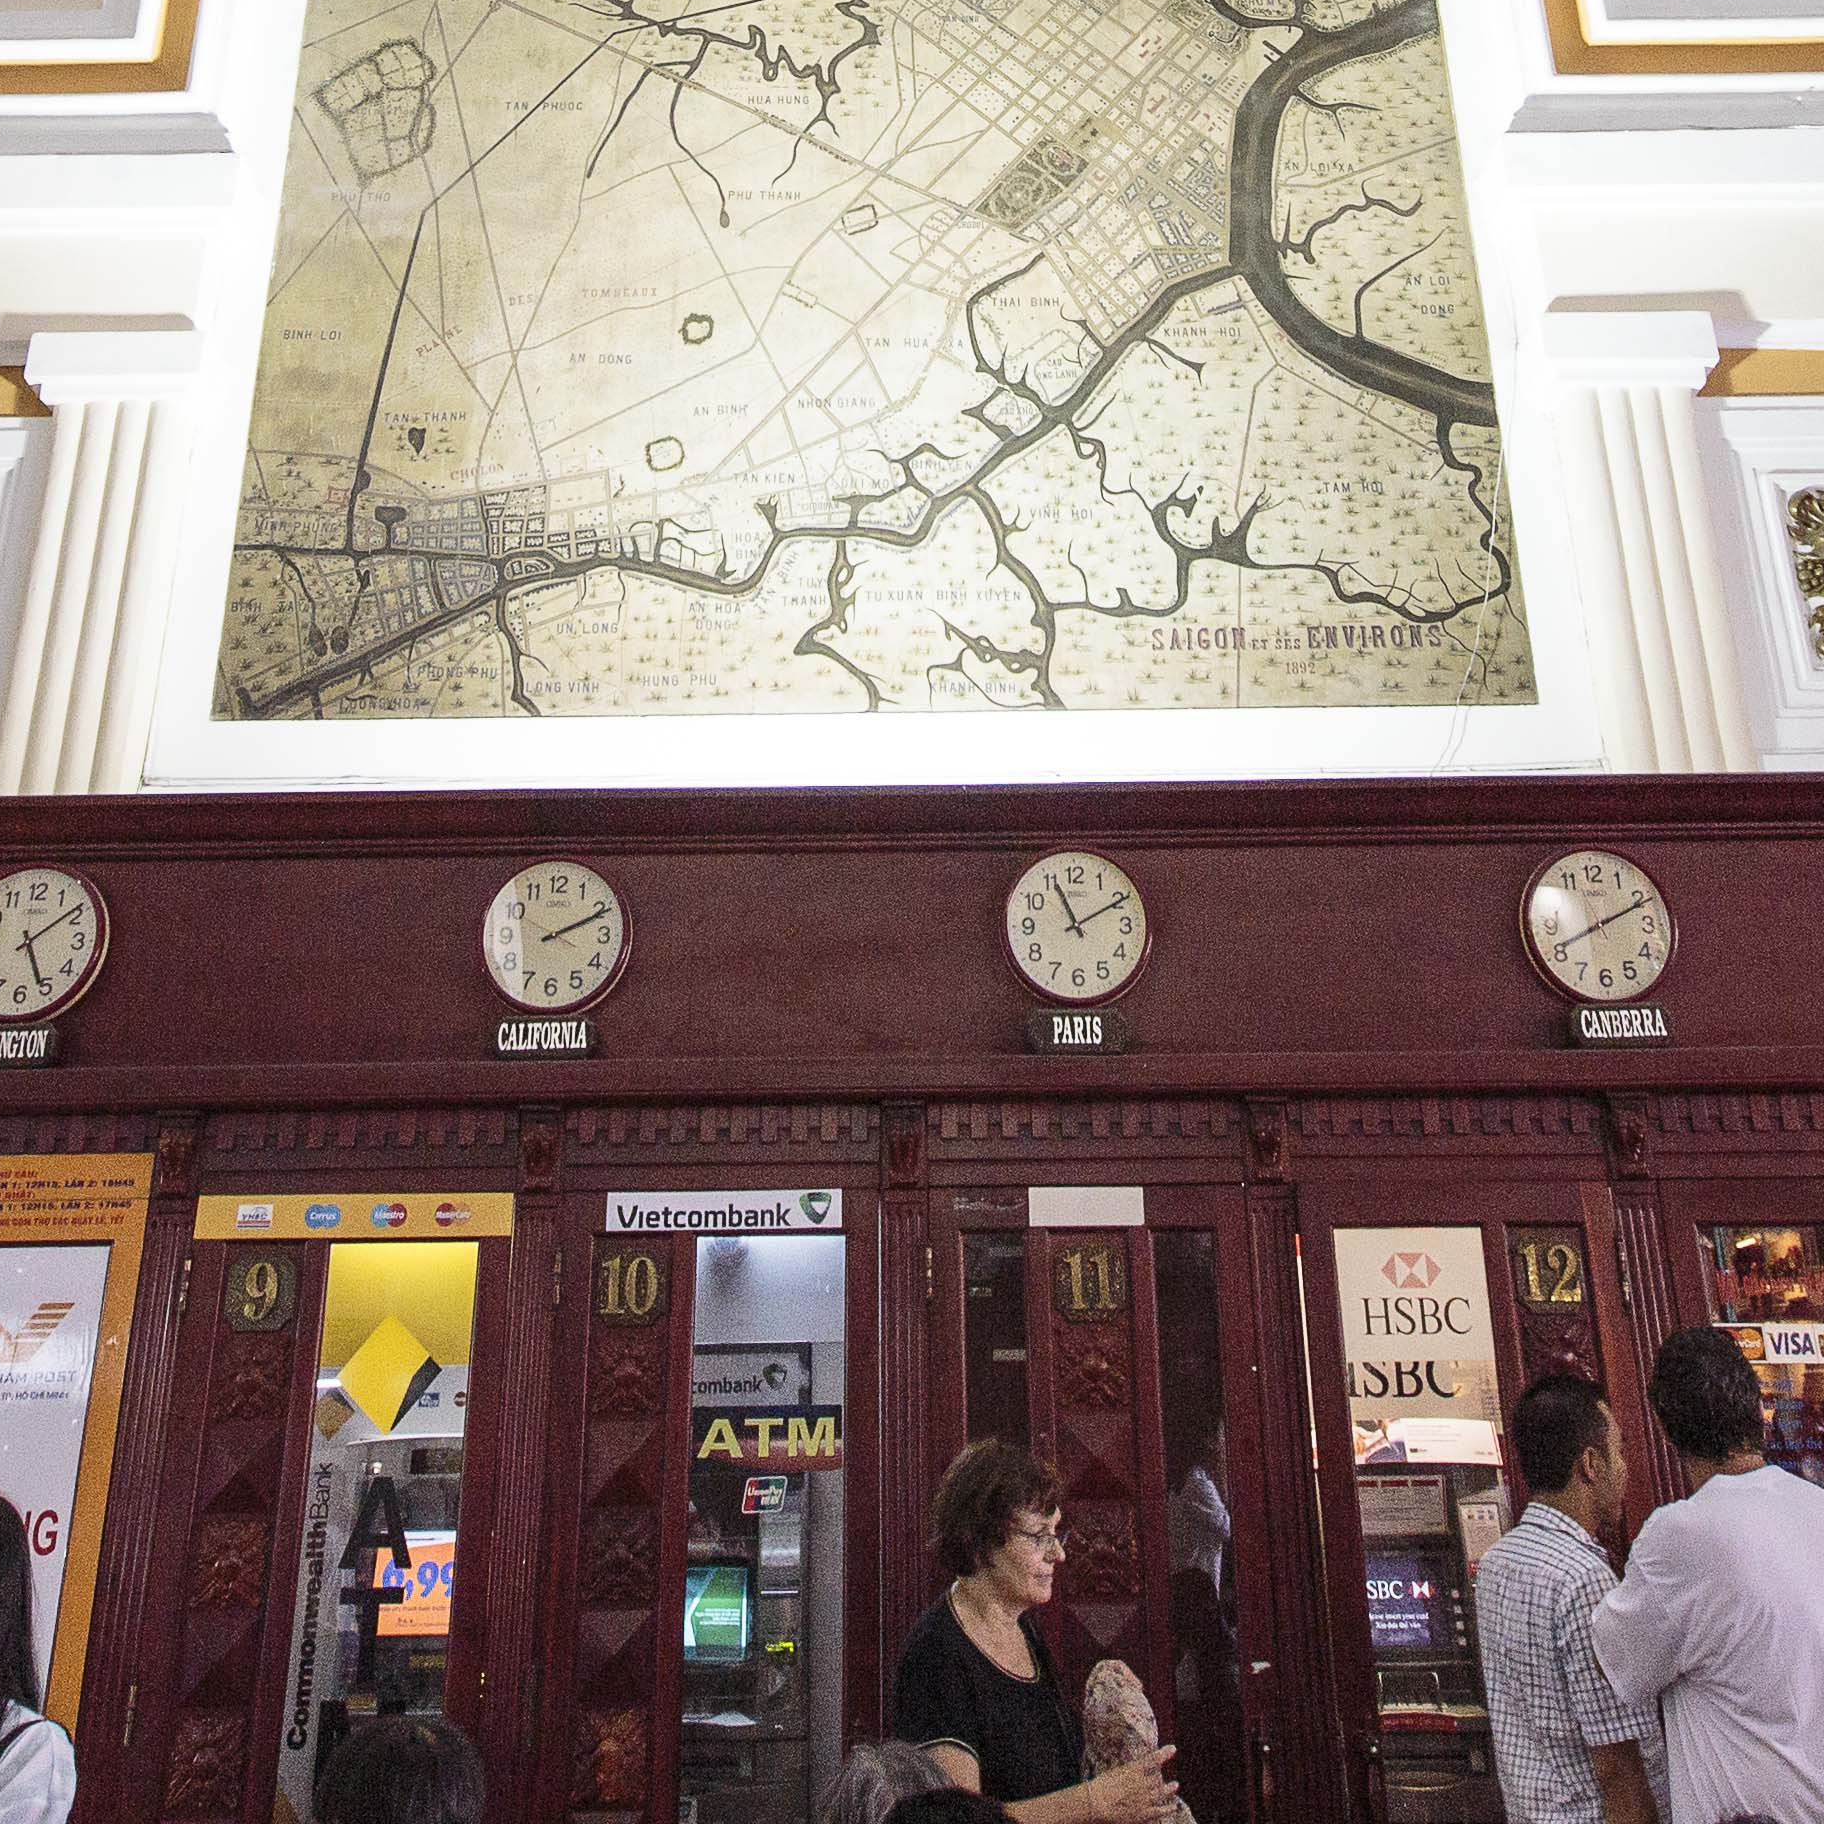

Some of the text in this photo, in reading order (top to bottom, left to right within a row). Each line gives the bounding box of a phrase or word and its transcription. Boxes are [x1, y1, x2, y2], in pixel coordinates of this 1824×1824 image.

[504, 101, 528, 111] TAN
[777, 95, 810, 105] HUNG
[727, 190, 801, 201] PHU THANH
[992, 297, 1060, 307] THAI BINH
[282, 329, 342, 341] BINH LOI
[1163, 327, 1208, 337] KHANH
[865, 338, 890, 348] TAN
[569, 352, 633, 365] AN DONG
[692, 404, 746, 416] AN BINH
[798, 398, 832, 408] NHON
[384, 411, 467, 423] TAN THANH
[911, 459, 941, 470] BINH
[764, 473, 795, 484] KIEN
[1323, 481, 1352, 493] TAM
[1029, 507, 1061, 520] VINH
[936, 590, 968, 601] BINH
[689, 603, 706, 614] AN
[582, 623, 619, 634] LONG
[1151, 624, 1443, 651] SAIGON ET SES ENVIRONS
[417, 665, 498, 680] PHONG PHU
[1285, 661, 1316, 675] 1892
[526, 681, 600, 694] LONG VINH
[642, 675, 717, 687] HUNG PHU
[985, 682, 1017, 693] BINH
[1065, 866, 1084, 884] 12
[1095, 872, 1103, 890] 1
[5, 891, 21, 908] 11
[29, 882, 49, 901] 12
[57, 889, 65, 907] 1
[1025, 892, 1044, 910] 10
[69, 905, 83, 926] 2
[1022, 917, 1035, 935] 9
[1119, 916, 1132, 934] 3
[71, 932, 85, 951] 3
[1028, 943, 1042, 962] 8
[1112, 942, 1126, 960] 4
[59, 958, 74, 977] 4
[1049, 961, 1062, 980] 7
[1096, 961, 1110, 979] 5
[39, 977, 53, 996] 5
[1072, 968, 1085, 987] 6
[13, 985, 27, 1004] 6
[1053, 1016, 1102, 1044] PARIS
[1581, 1008, 1668, 1038] CANBERRA
[498, 1021, 587, 1051] CALIFORNIA
[309, 1210, 337, 1222] Cirrus
[616, 1202, 792, 1231] Vietcombank
[1067, 1251, 1116, 1311] 11
[1520, 1242, 1581, 1303] 12
[242, 1263, 277, 1320] 9
[601, 1254, 658, 1316] 10
[1362, 1296, 1473, 1336] HSBC
[1767, 1331, 1815, 1355] VISA
[33, 1370, 77, 1383] POST
[697, 1416, 837, 1459] ATM
[286, 1462, 334, 1751] CommonwealthBank
